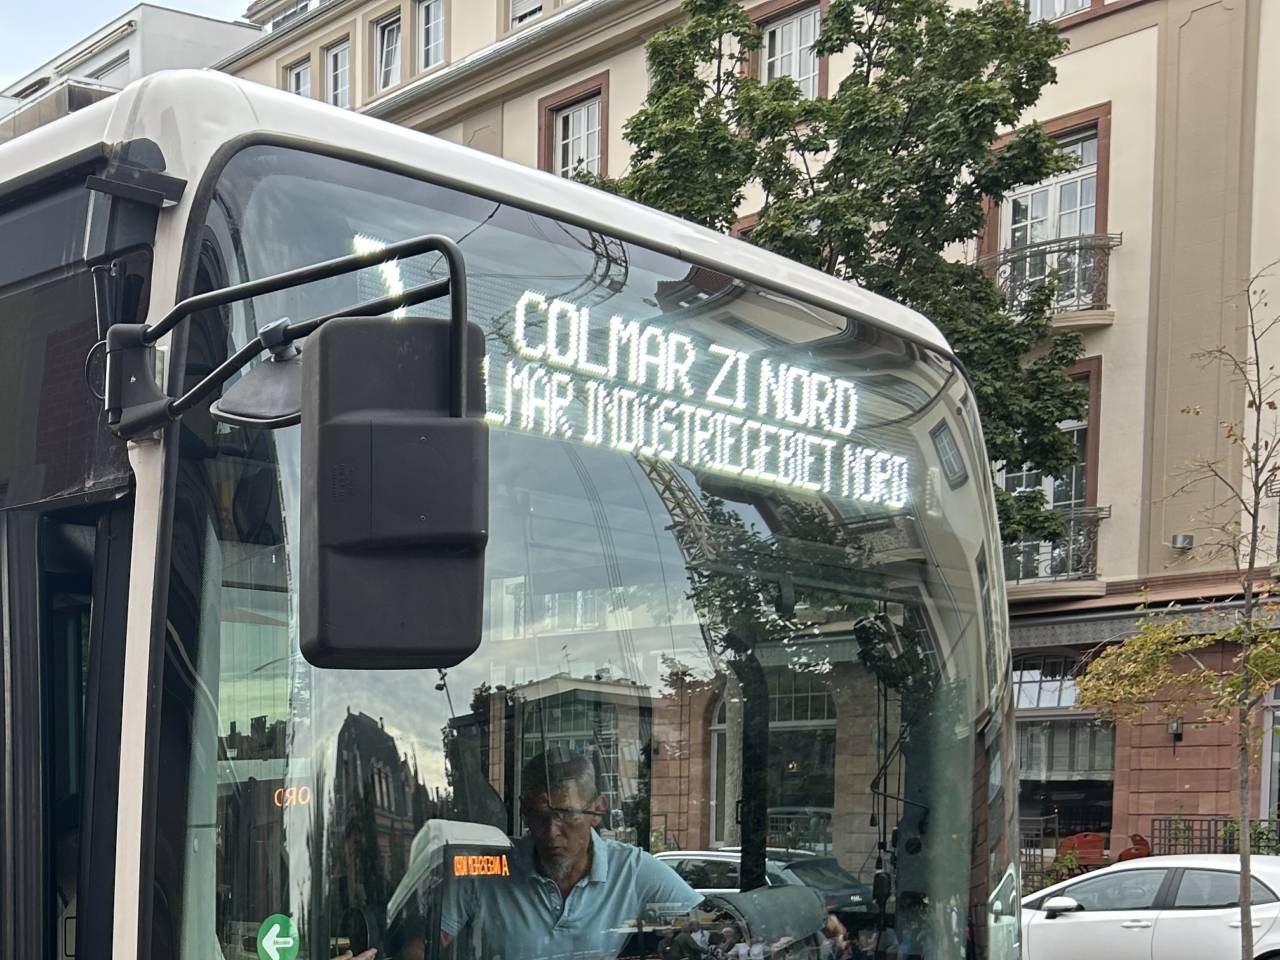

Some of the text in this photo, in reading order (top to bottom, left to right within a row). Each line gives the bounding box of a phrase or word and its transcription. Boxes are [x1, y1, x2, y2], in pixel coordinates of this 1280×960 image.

[513, 290, 858, 436] COLMAR ZI NORD
